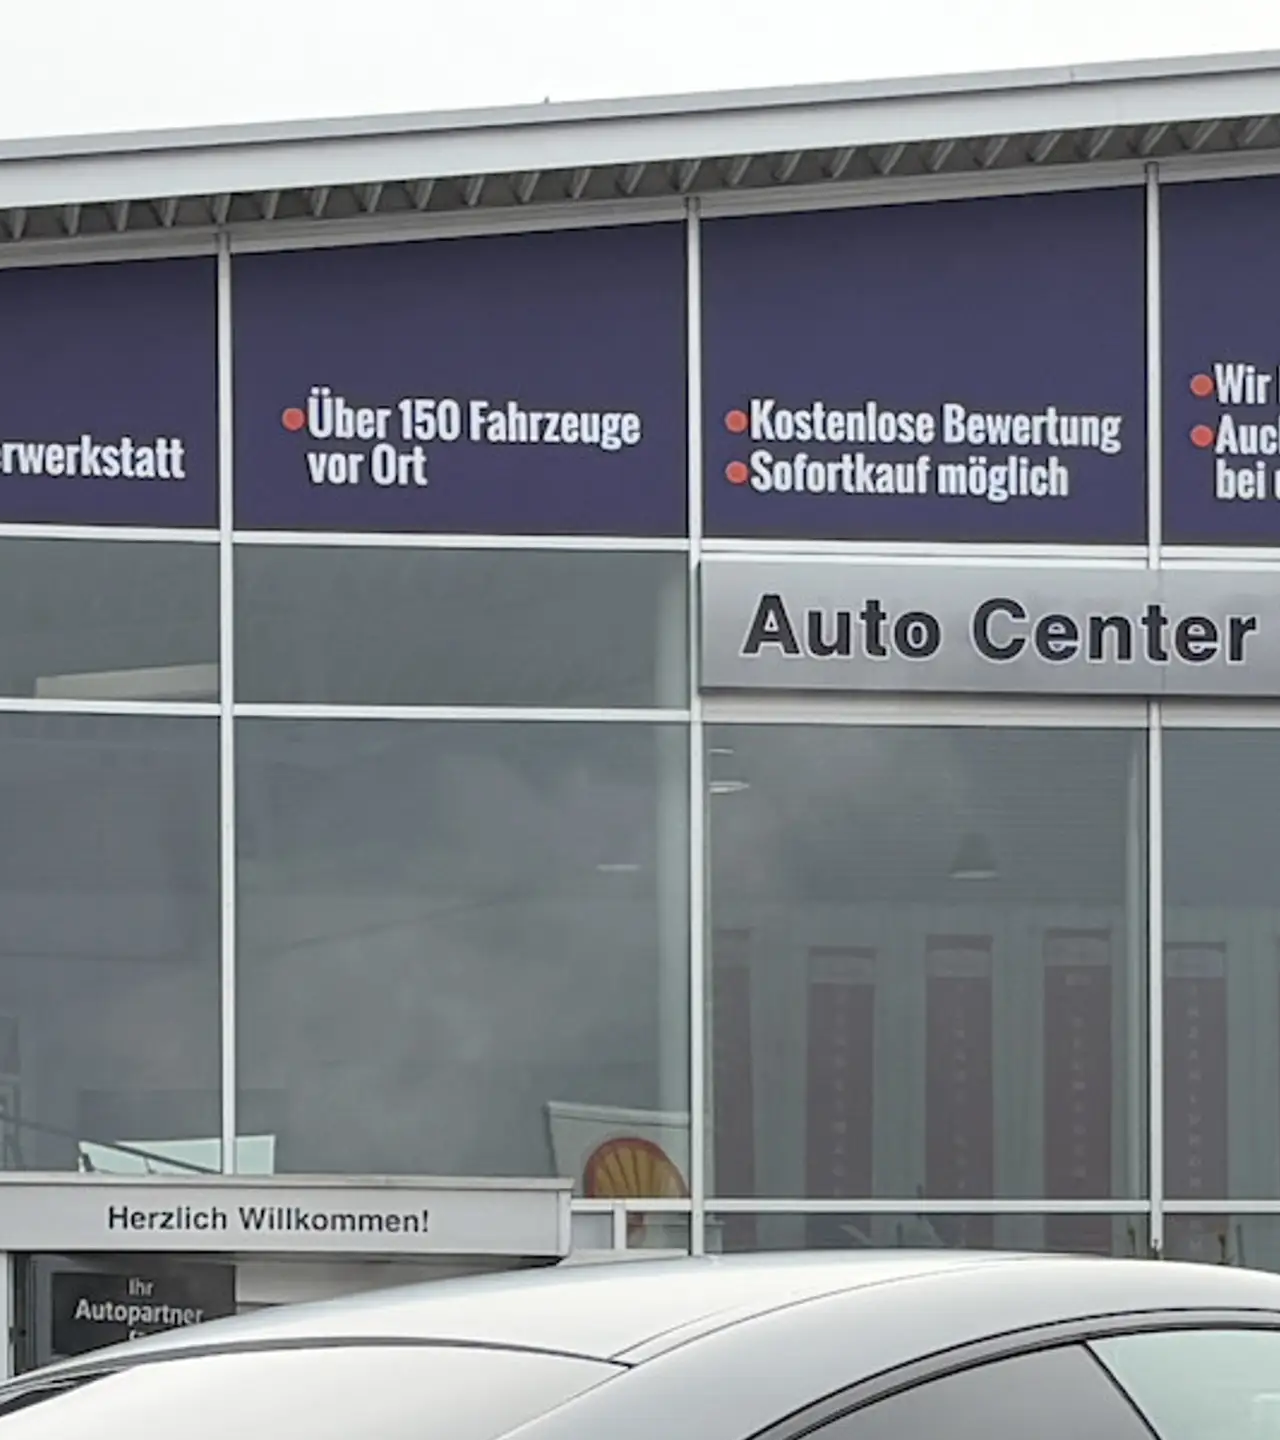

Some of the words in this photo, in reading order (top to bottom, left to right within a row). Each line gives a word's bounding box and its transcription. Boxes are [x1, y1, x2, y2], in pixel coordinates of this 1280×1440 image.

[1214, 363, 1271, 404] Wir
[307, 387, 392, 439] Über
[398, 398, 461, 441] 150
[469, 400, 642, 451] Fahrzeuge
[749, 398, 936, 444] Kostenlose
[942, 402, 1122, 454] Bewertung
[307, 451, 365, 485] vor
[371, 443, 429, 486] Ort
[749, 449, 931, 494] Sofortkauf
[937, 455, 1069, 502] möglich
[1215, 458, 1266, 500] bei
[741, 593, 942, 660] Auto
[971, 596, 1258, 664] Center
[108, 1206, 228, 1230] Herzlich
[238, 1207, 429, 1233] Willkommen!
[128, 1278, 154, 1297] Ihr
[75, 1298, 204, 1326] Autopartner
